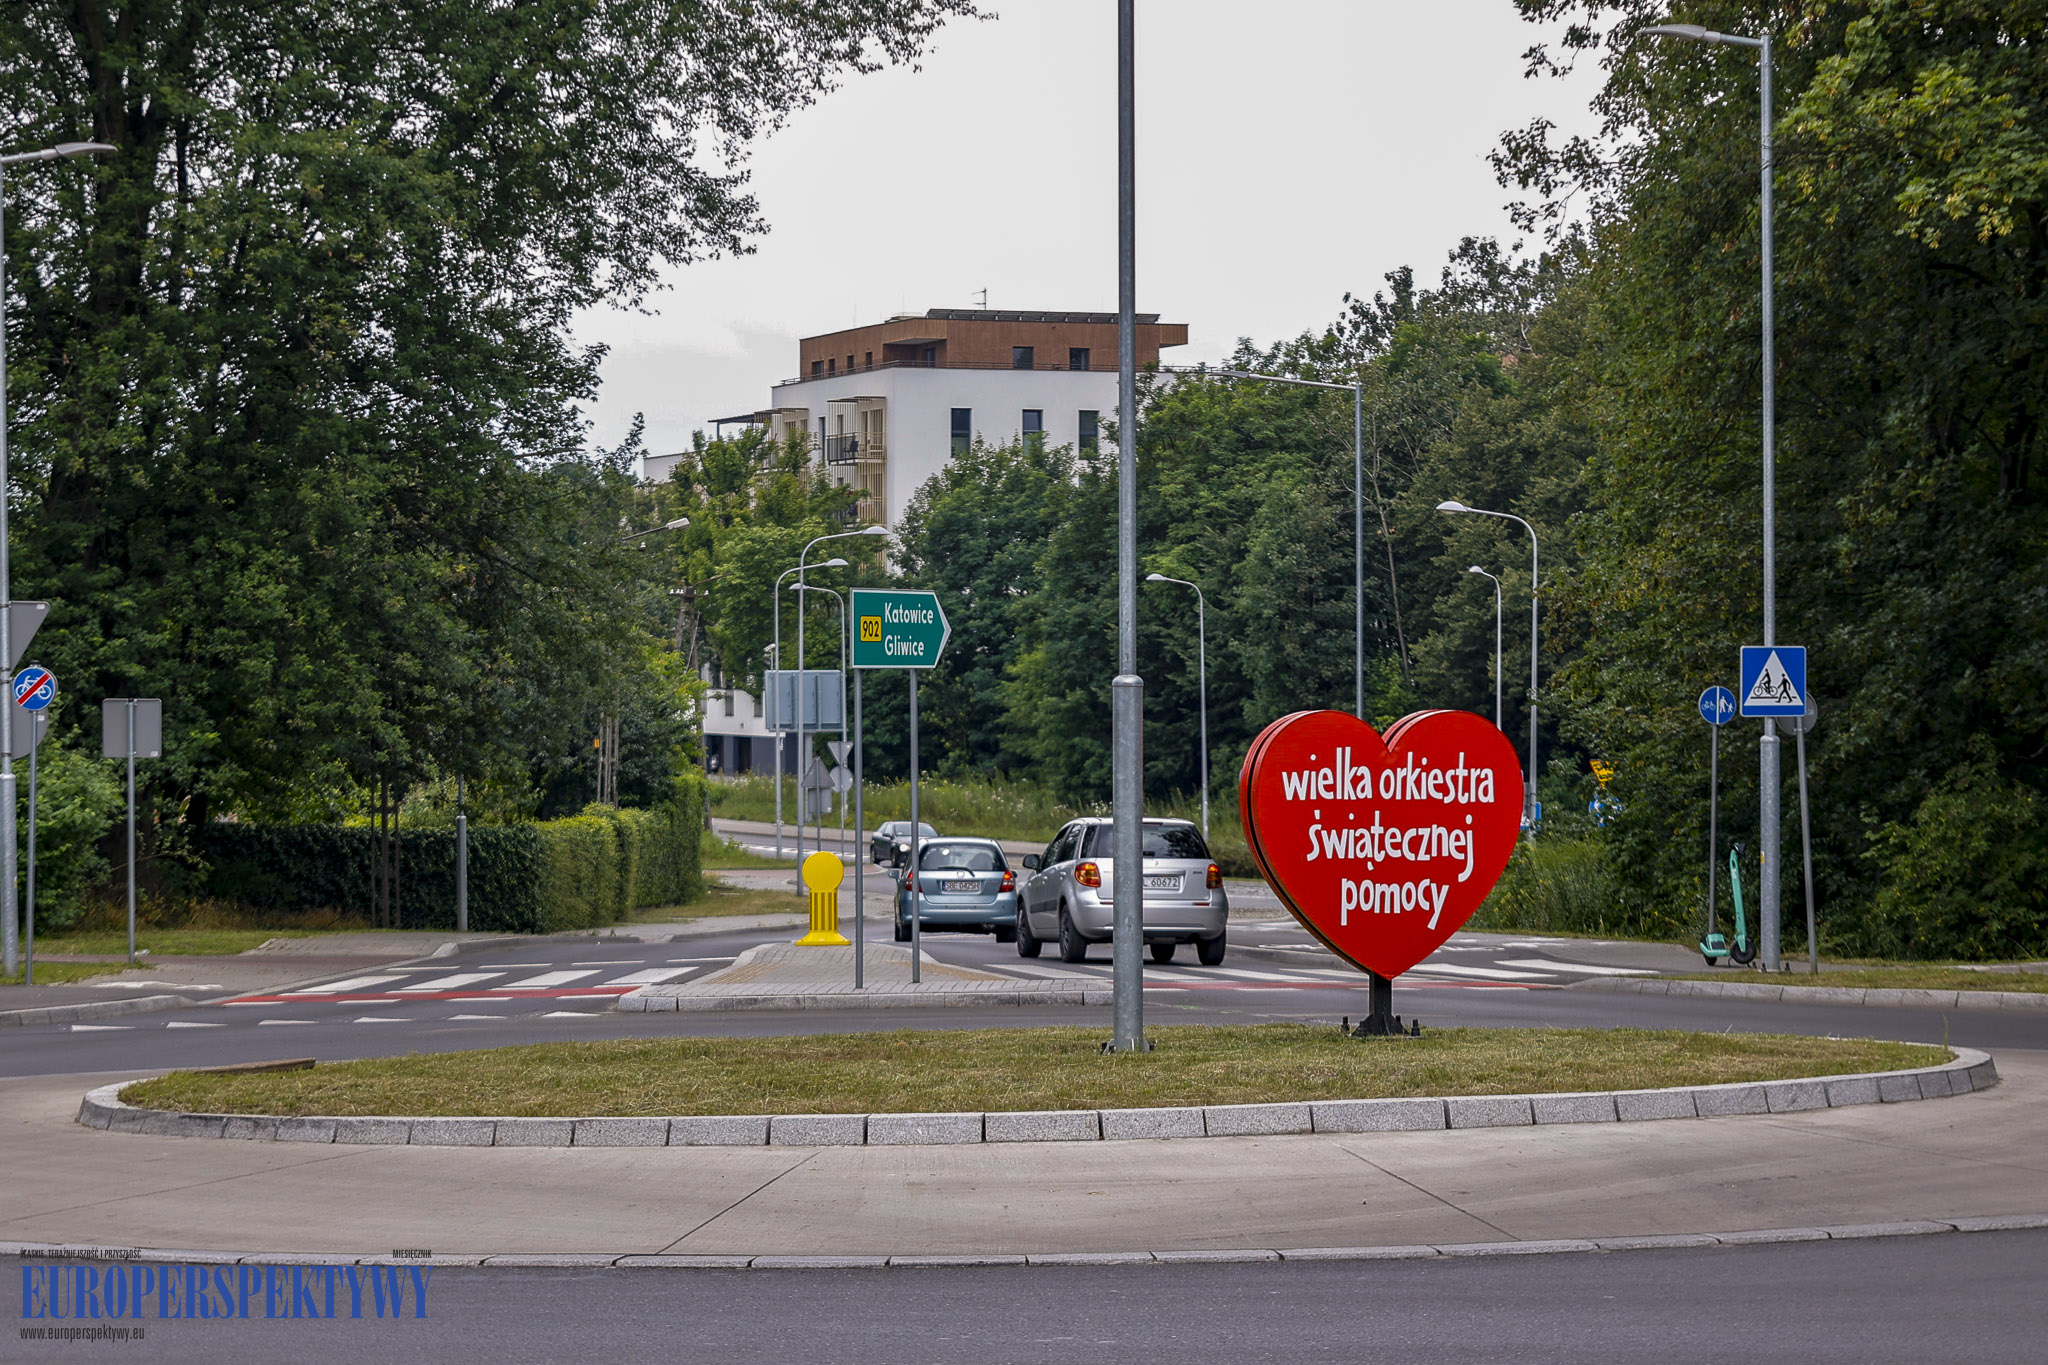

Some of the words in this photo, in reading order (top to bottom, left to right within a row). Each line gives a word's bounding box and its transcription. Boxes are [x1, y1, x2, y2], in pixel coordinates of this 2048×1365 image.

[884, 602, 934, 624] Katowice
[862, 620, 880, 638] 902
[884, 634, 925, 656] Gliwice
[1281, 746, 1373, 801] wielka
[1378, 751, 1495, 804] orkiestra
[1306, 809, 1475, 883] świątecznej
[1151, 877, 1177, 887] 60672
[1340, 878, 1450, 930] pomocy
